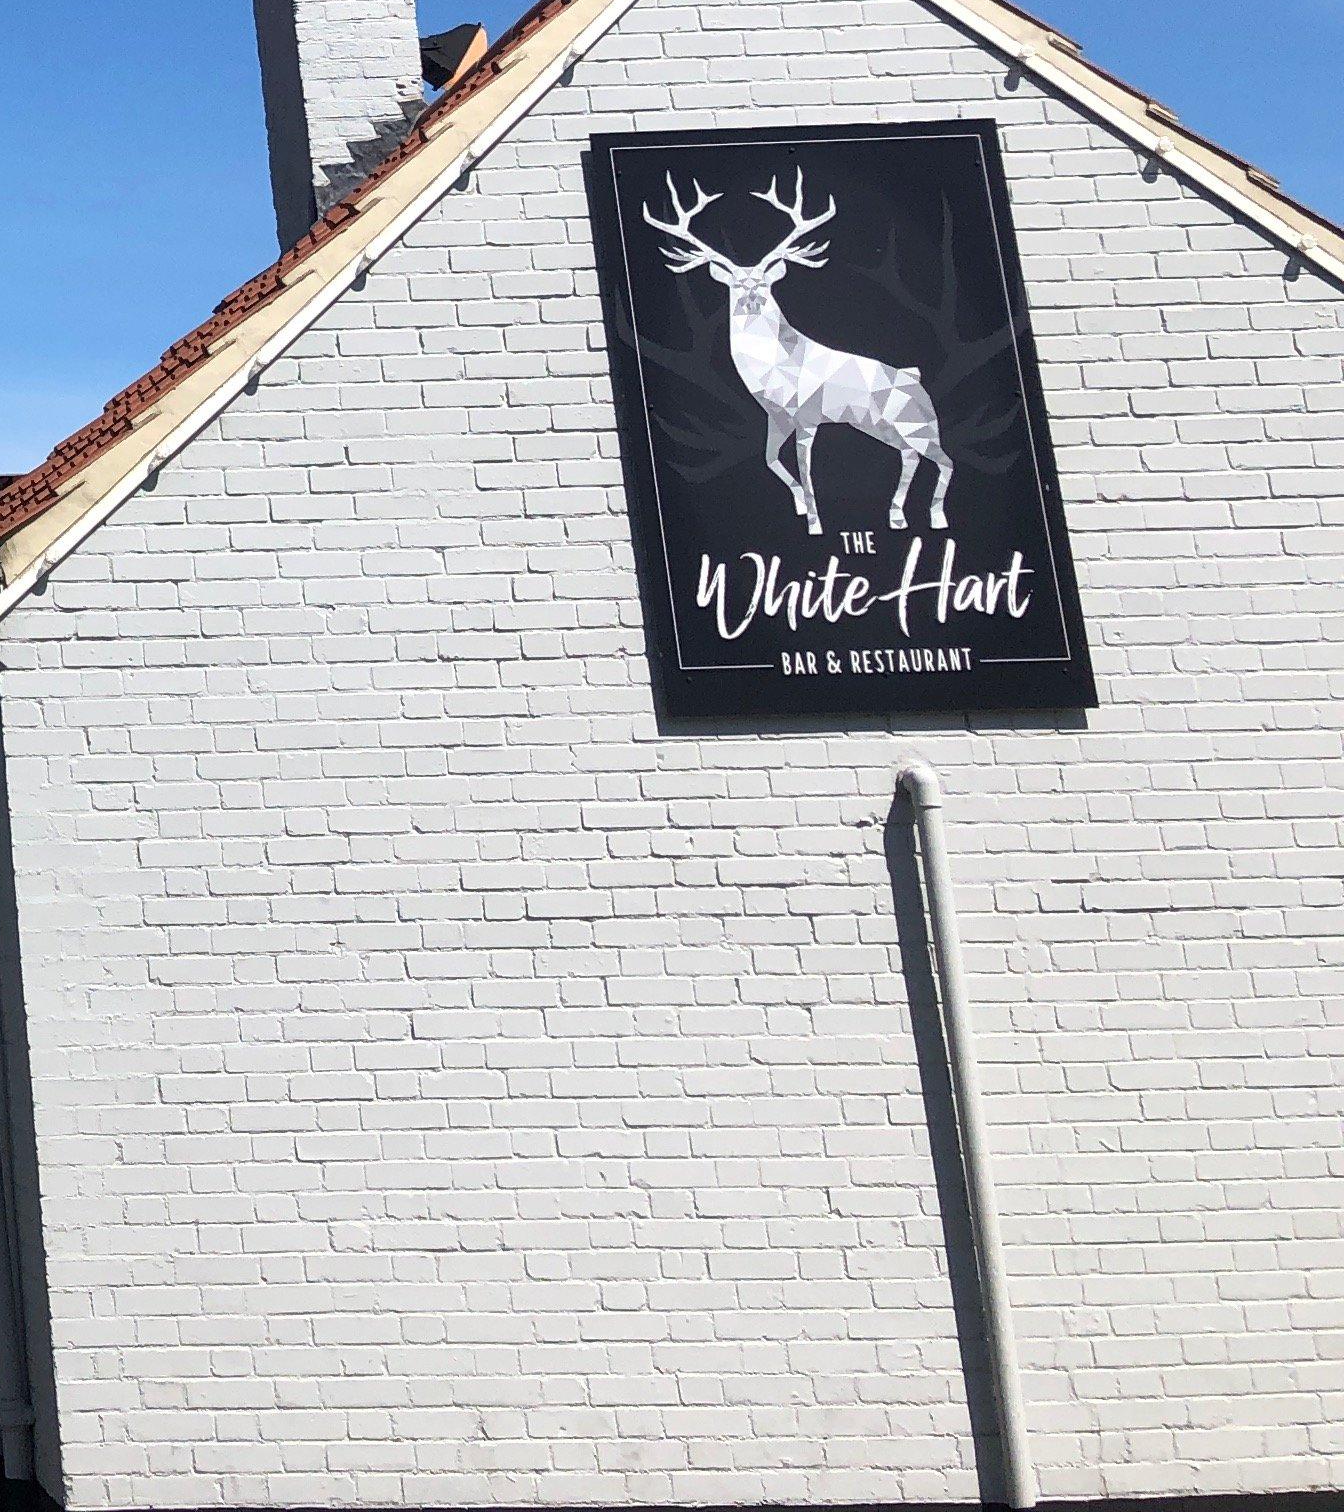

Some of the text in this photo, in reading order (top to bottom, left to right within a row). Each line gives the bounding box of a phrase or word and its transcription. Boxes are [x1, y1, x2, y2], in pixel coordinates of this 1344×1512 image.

[840, 531, 877, 554] THE
[696, 536, 1035, 639] White Hart
[781, 647, 972, 675] BAR & RESTAURANT
